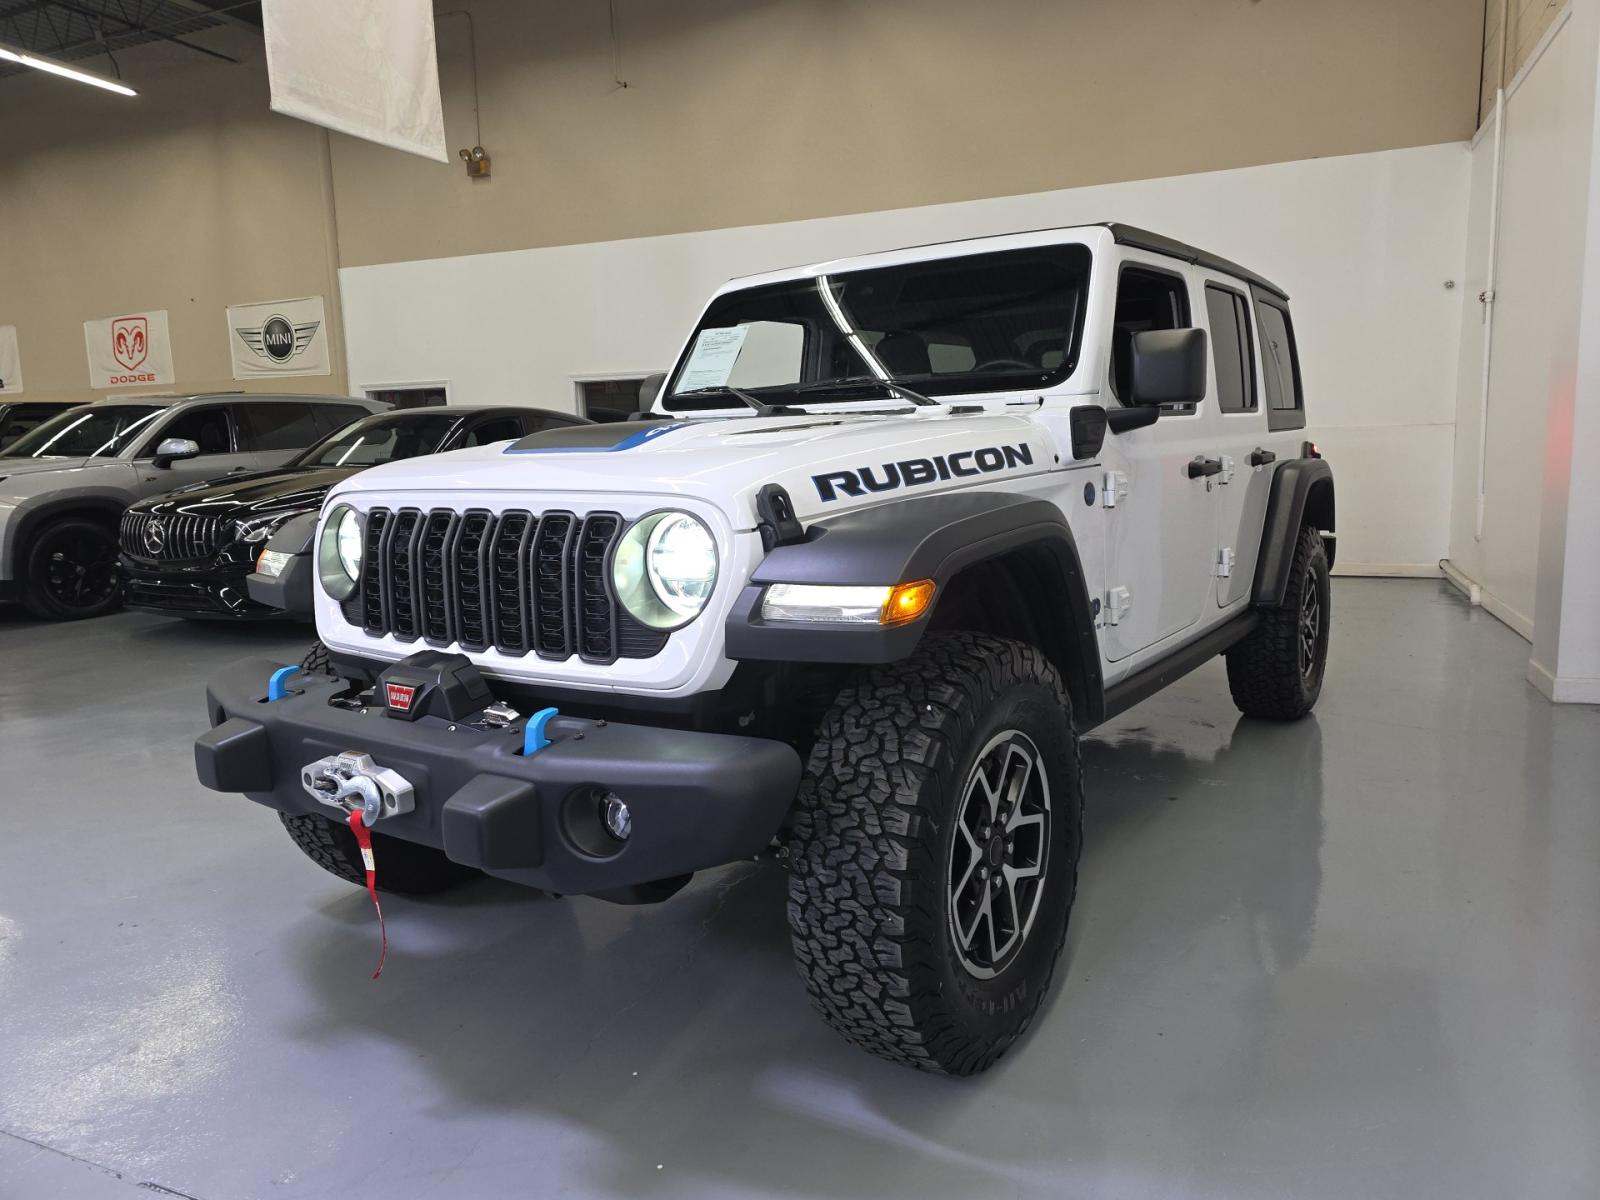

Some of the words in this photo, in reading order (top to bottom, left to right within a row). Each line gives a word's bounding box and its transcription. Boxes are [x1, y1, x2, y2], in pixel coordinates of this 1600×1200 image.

[266, 332, 292, 345] MINI
[110, 373, 156, 384] DODGE
[811, 443, 1034, 503] RUBICON
[390, 691, 409, 702] WARN
